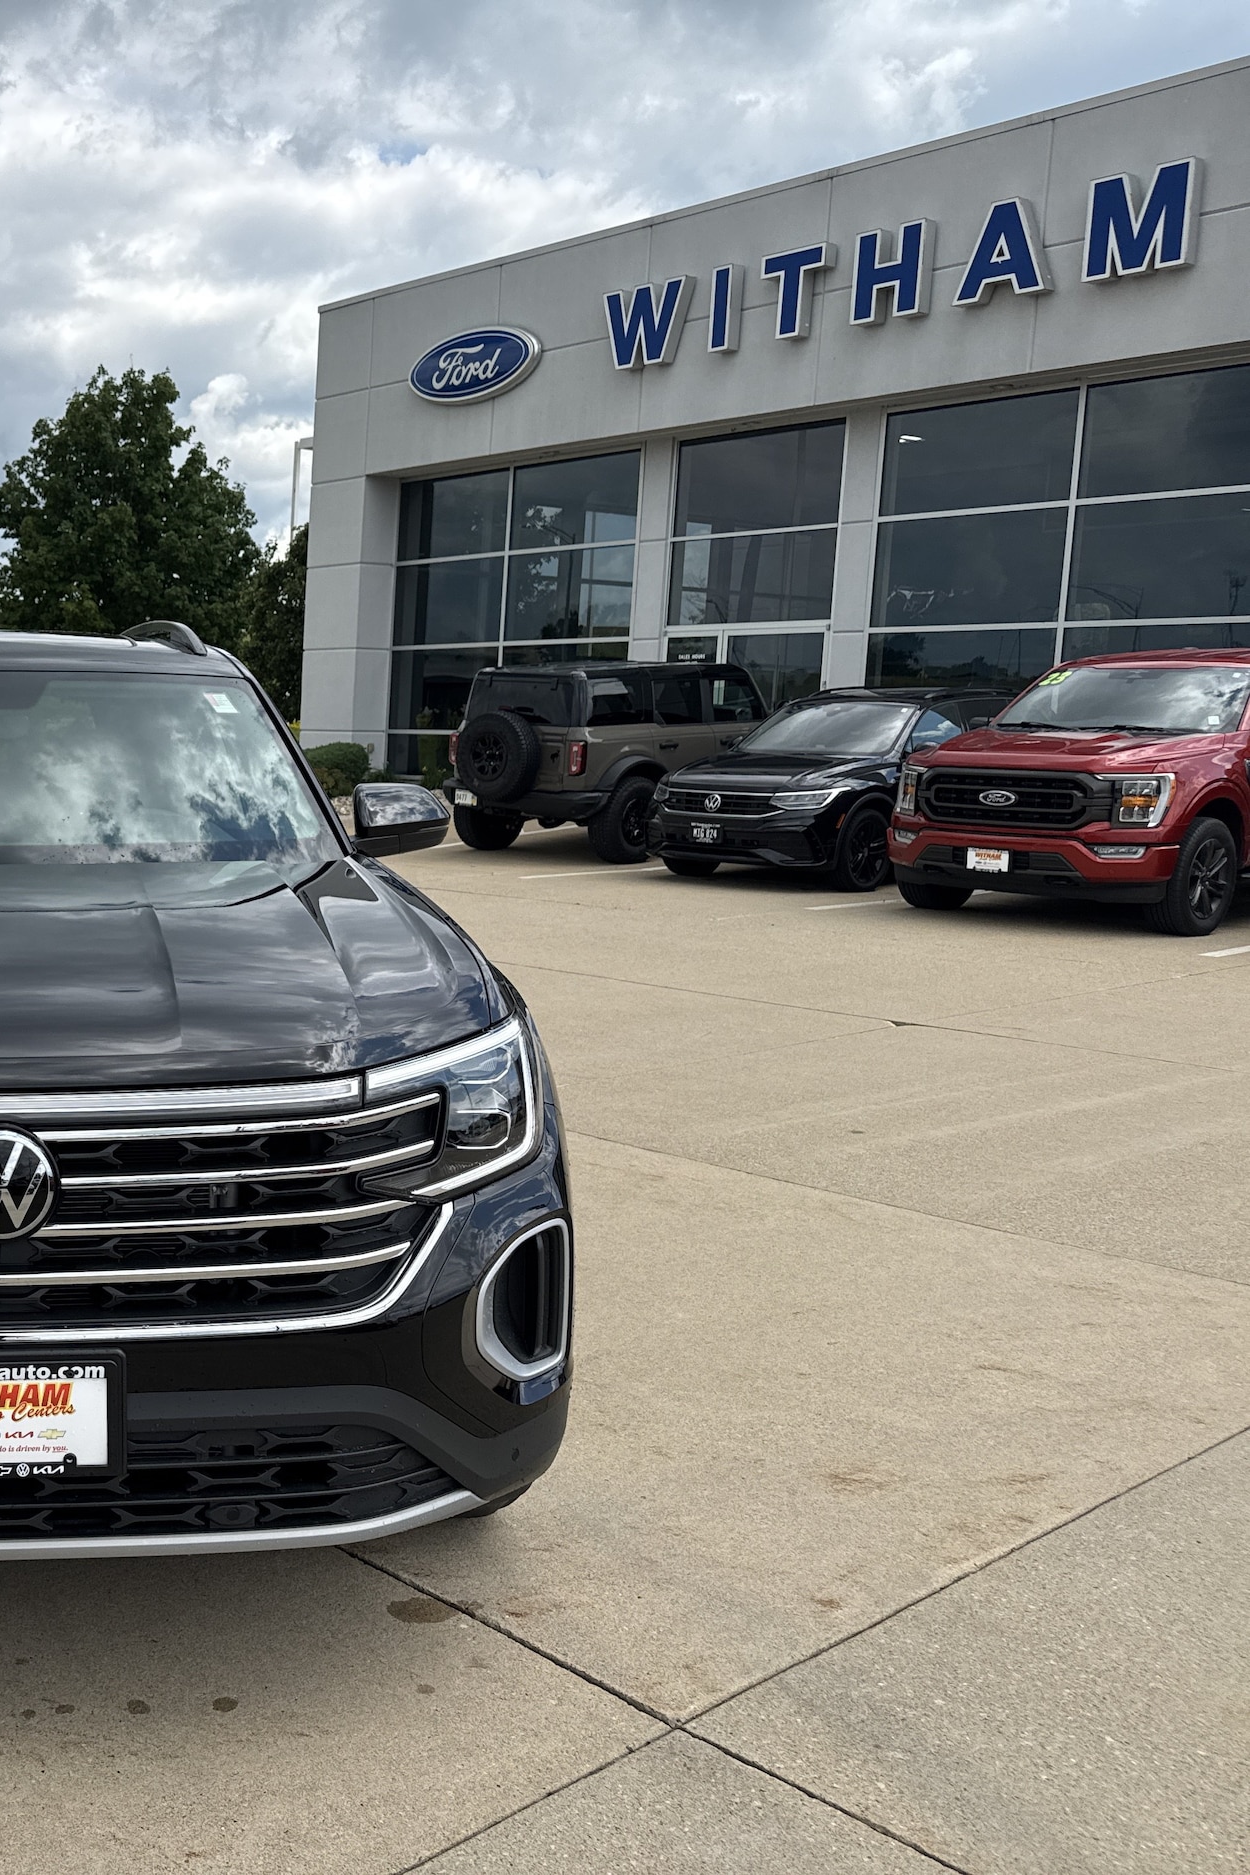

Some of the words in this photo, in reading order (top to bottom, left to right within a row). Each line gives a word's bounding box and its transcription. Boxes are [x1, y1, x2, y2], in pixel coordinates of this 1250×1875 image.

[602, 155, 1200, 371] WITHAM
[432, 343, 501, 390] Ford
[1038, 671, 1073, 686] 23
[986, 793, 1007, 803] Ford
[11, 1402, 76, 1422] Centers
[8, 1445, 15, 1453] is
[16, 1444, 40, 1453] driven
[42, 1444, 51, 1454] by
[52, 1445, 69, 1454] you.
